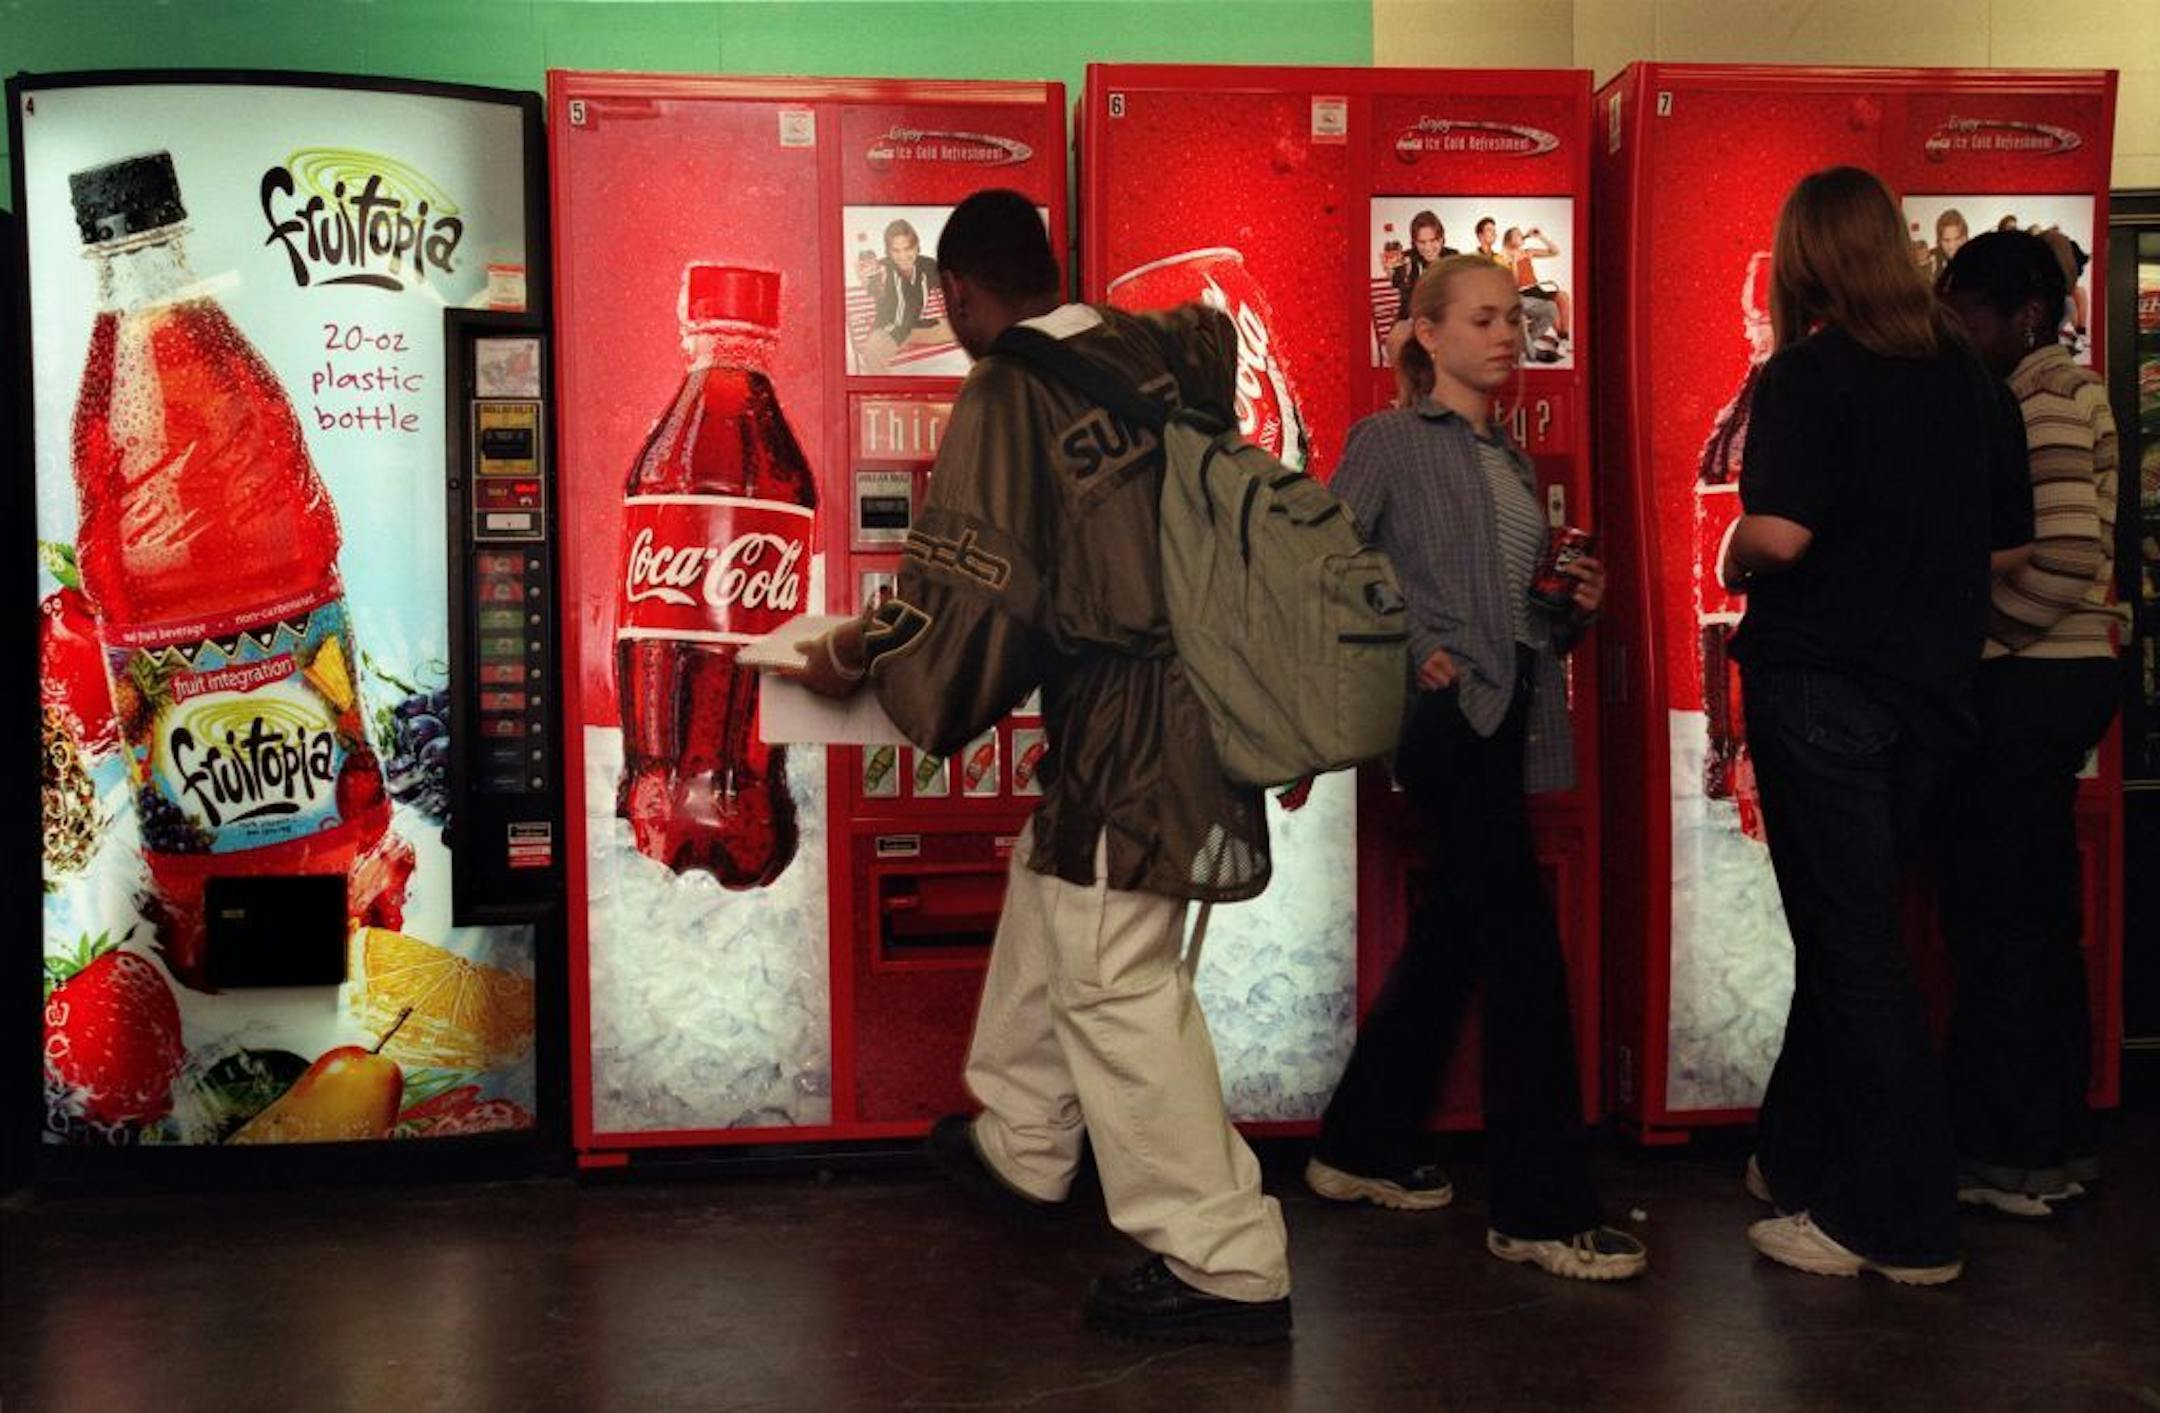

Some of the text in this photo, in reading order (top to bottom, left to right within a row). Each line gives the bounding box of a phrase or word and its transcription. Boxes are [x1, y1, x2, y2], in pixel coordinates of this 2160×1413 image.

[573, 103, 583, 122] 5
[1111, 96, 1121, 114] 6
[1662, 94, 1669, 113] 7
[916, 145, 937, 160] Cold
[940, 145, 1002, 161] Refreshment
[1444, 136, 1465, 150] Cold
[1469, 136, 1530, 151] Refreshment
[323, 324, 410, 352] 20-oz
[312, 362, 424, 395] plastic
[314, 403, 420, 432] bottle
[867, 409, 942, 451] Thir
[626, 527, 803, 611] Coca-Cola
[173, 658, 294, 704] fruit integration
